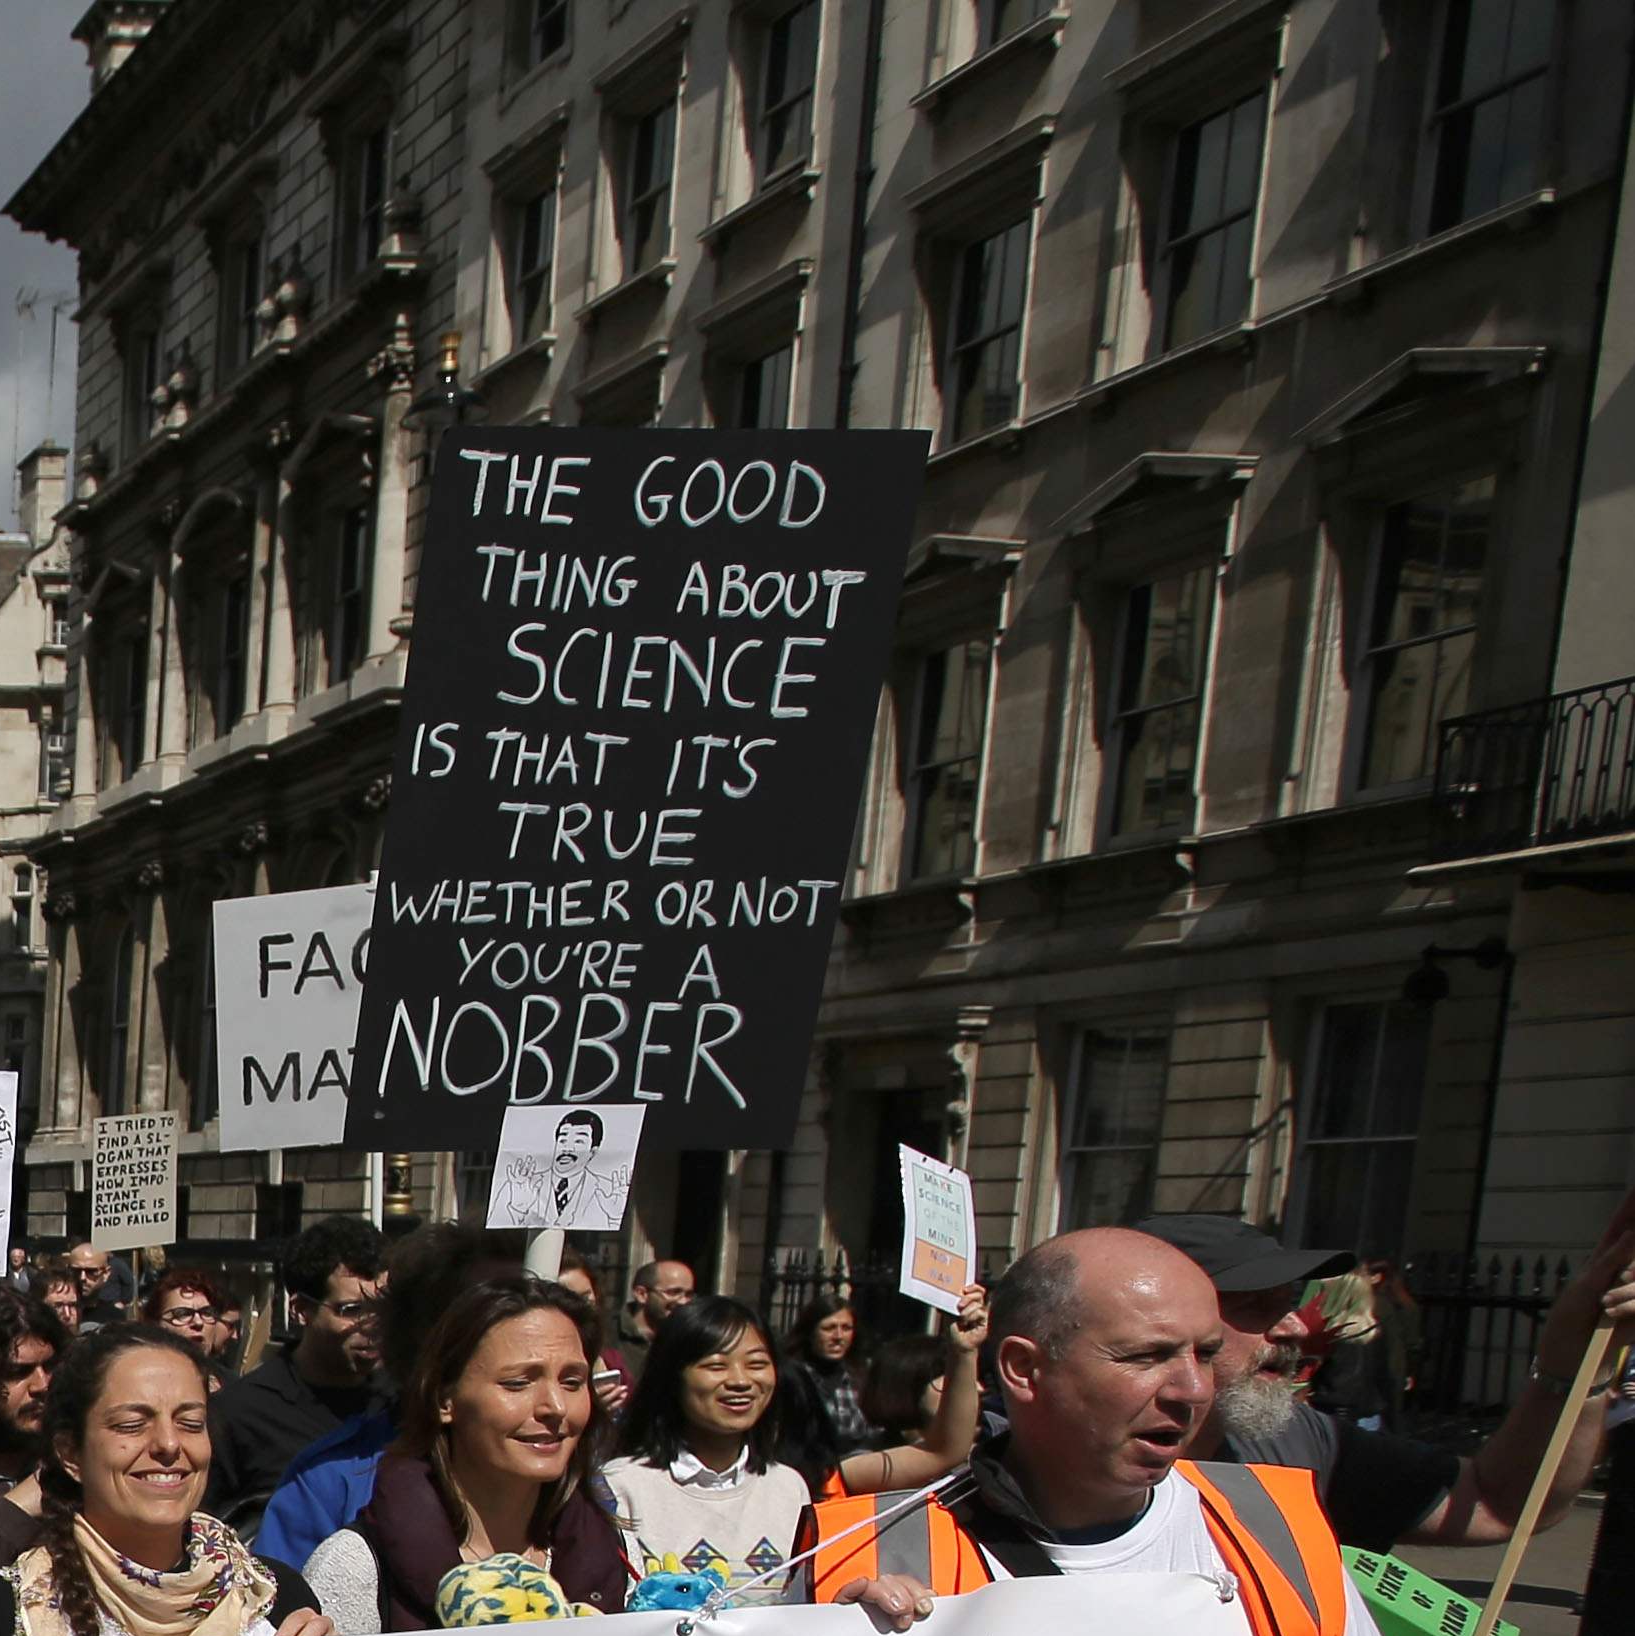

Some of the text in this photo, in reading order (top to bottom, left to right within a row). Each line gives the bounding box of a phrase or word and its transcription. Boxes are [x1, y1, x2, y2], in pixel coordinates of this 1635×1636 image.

[459, 448, 826, 529] THE GOOD
[476, 543, 867, 629] THING ABOUT
[496, 623, 826, 718] SCIENCE
[411, 723, 777, 799] IS THAT IT'S
[498, 803, 703, 867] TRUE
[391, 878, 839, 930] WHETHER OR NOT
[457, 938, 721, 1000] YOU'RE A
[378, 993, 747, 1110] NOBBER
[243, 1047, 356, 1106] MA
[99, 1117, 174, 1134] I TRIED TO
[96, 1145, 171, 1165] OGAN THAT
[97, 1136, 129, 1149] FIND
[133, 1134, 141, 1145] A
[97, 1160, 168, 1178] EXPRESSES
[96, 1178, 124, 1191] HOW
[96, 1189, 140, 1204] RTANT
[95, 1198, 165, 1216] SCIENCE IS
[918, 1187, 961, 1214] SCIENCE
[94, 1212, 169, 1228] AND FAILED
[928, 1227, 955, 1248] MIND
